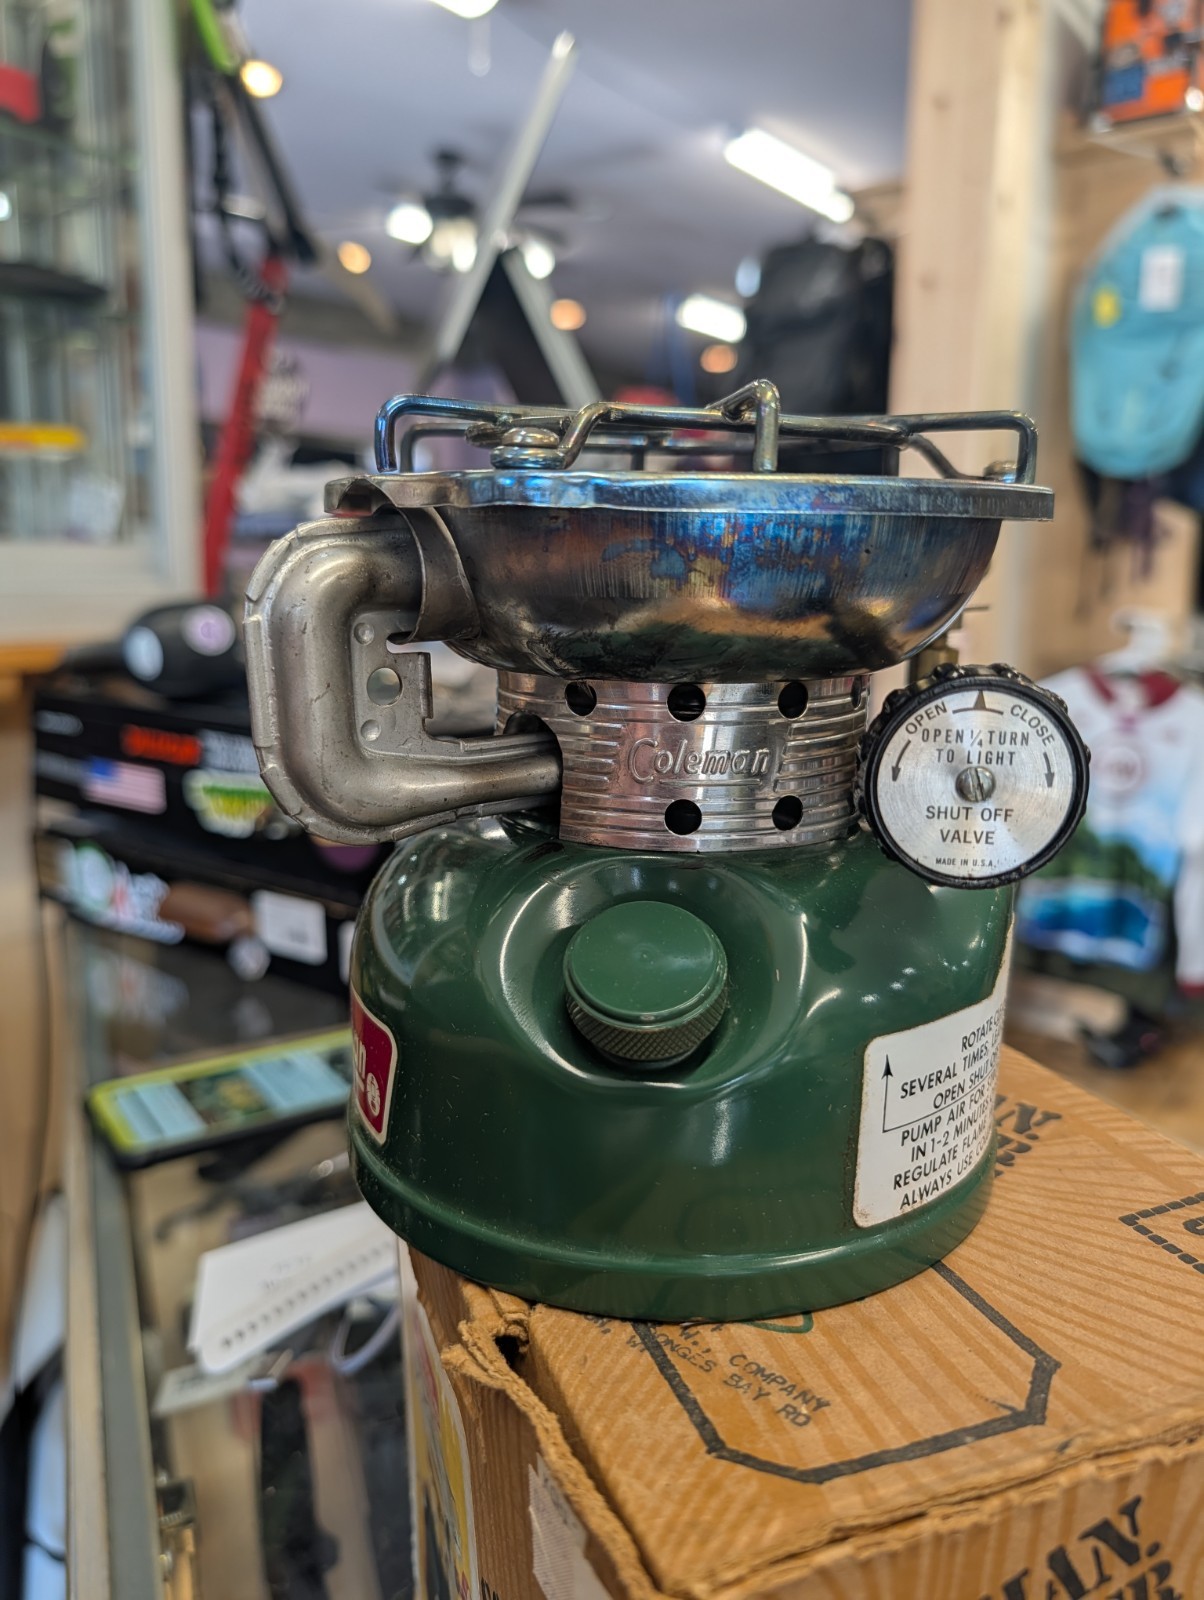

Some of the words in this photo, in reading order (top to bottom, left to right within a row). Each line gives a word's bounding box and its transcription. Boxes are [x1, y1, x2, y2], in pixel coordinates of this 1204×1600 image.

[905, 701, 949, 736] OPEN
[920, 727, 965, 744] OPEN
[986, 729, 1031, 747] TURN
[1009, 703, 1056, 747] CLOSE
[627, 736, 771, 785] Coleman
[936, 748, 955, 764] TO
[966, 751, 1016, 766] LIGHT
[925, 805, 974, 822] SHUT
[980, 807, 1014, 823] OFF
[939, 828, 996, 846] VALVE
[935, 857, 956, 866] MADE
[960, 858, 969, 867] IN
[972, 858, 997, 869] U.S.A.
[961, 1015, 993, 1053] ROTATE
[900, 1062, 957, 1099] SEVERAL
[963, 1040, 989, 1072] TIMES
[933, 1078, 965, 1110] OPEN
[969, 1058, 989, 1089] SHUT
[901, 1114, 941, 1147] PUMP
[947, 1100, 966, 1126] AIR
[969, 1084, 985, 1110] FOR
[911, 1142, 926, 1163] IN
[931, 1130, 949, 1154] 1-2
[953, 1097, 988, 1141] MINUTES
[893, 1146, 958, 1190] REGULATE
[962, 1114, 987, 1153] FLAME
[899, 1169, 952, 1211] ALWAYS
[957, 1149, 973, 1176] USE
[722, 1373, 771, 1402] BAY
[775, 1403, 813, 1428] RD
[727, 1352, 832, 1413] COMPANY
